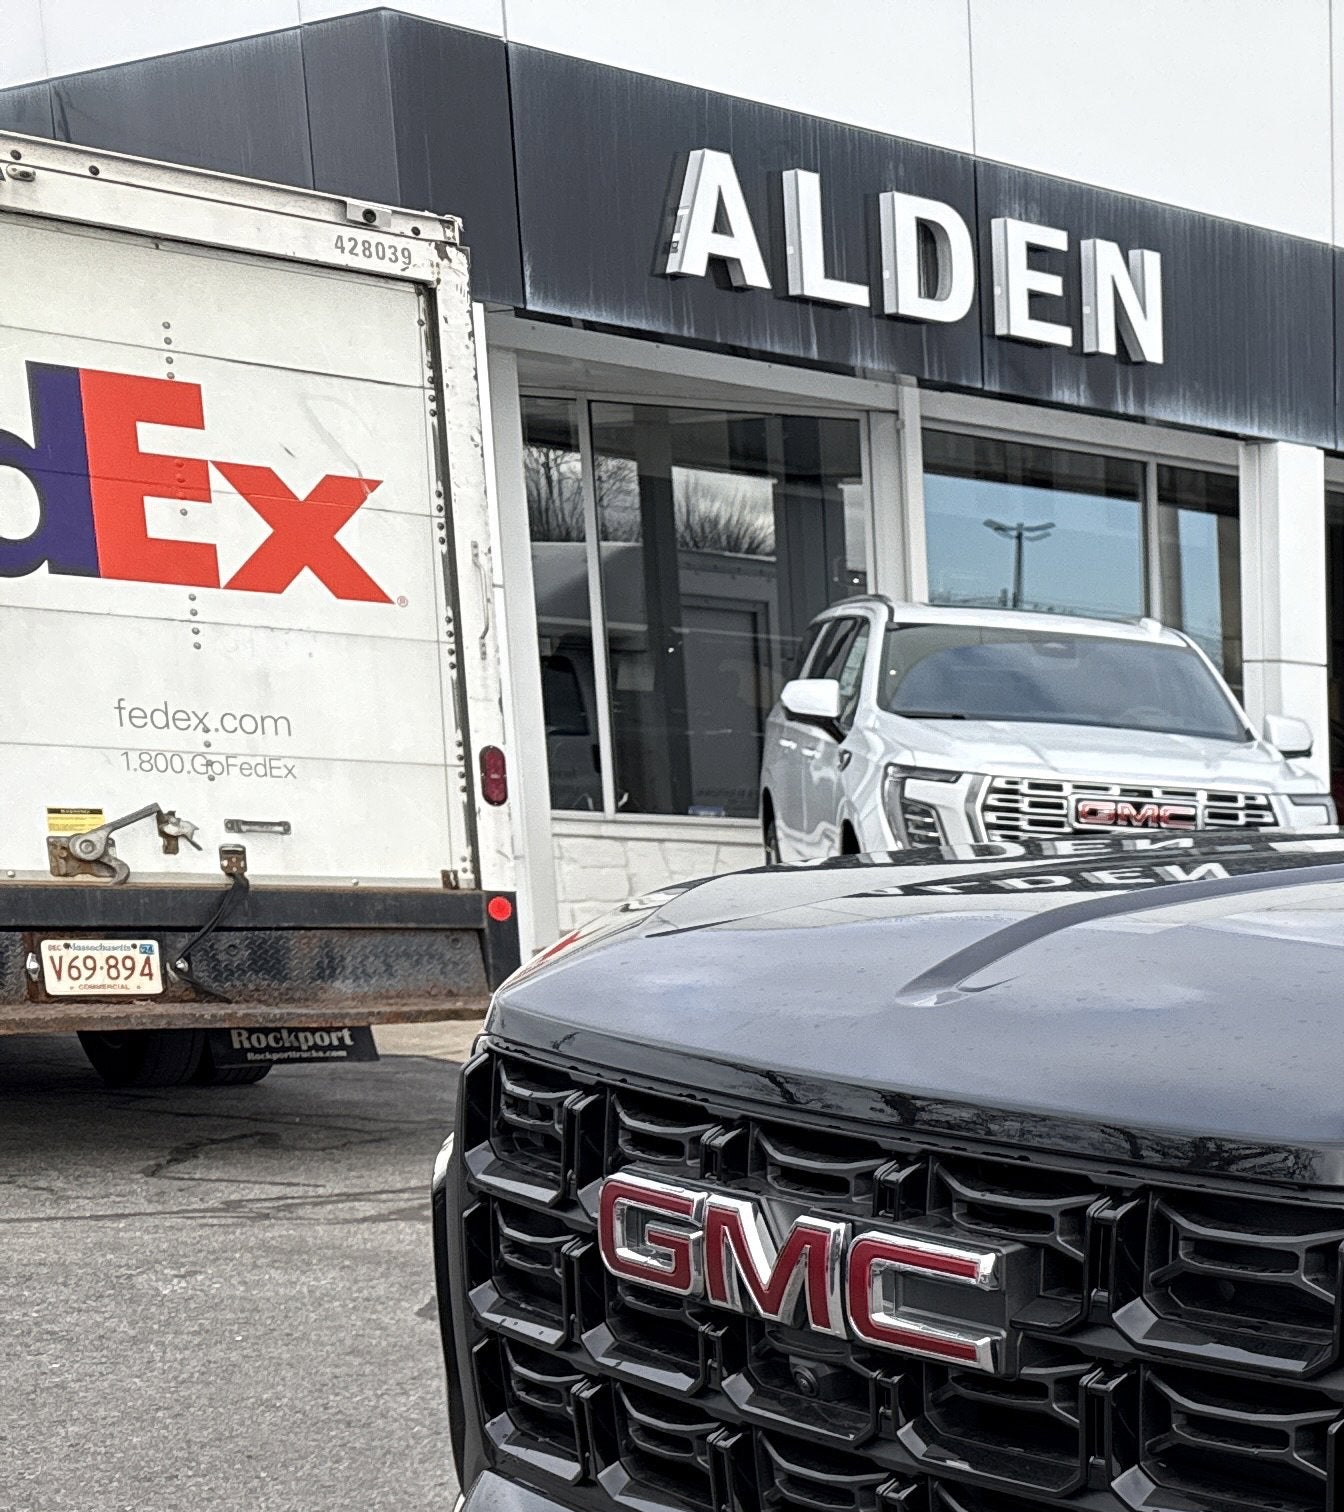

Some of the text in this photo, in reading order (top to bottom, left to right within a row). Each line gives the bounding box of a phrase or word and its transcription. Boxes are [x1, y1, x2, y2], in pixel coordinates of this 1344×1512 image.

[334, 234, 412, 266] 428039
[666, 148, 1163, 364] ALDEN
[114, 698, 292, 737] fedex.com
[120, 751, 297, 780] 1.800.GoFedEx
[1077, 800, 1197, 831] GMC
[230, 1027, 355, 1051] Rockport
[599, 1172, 1003, 1375] GMC
